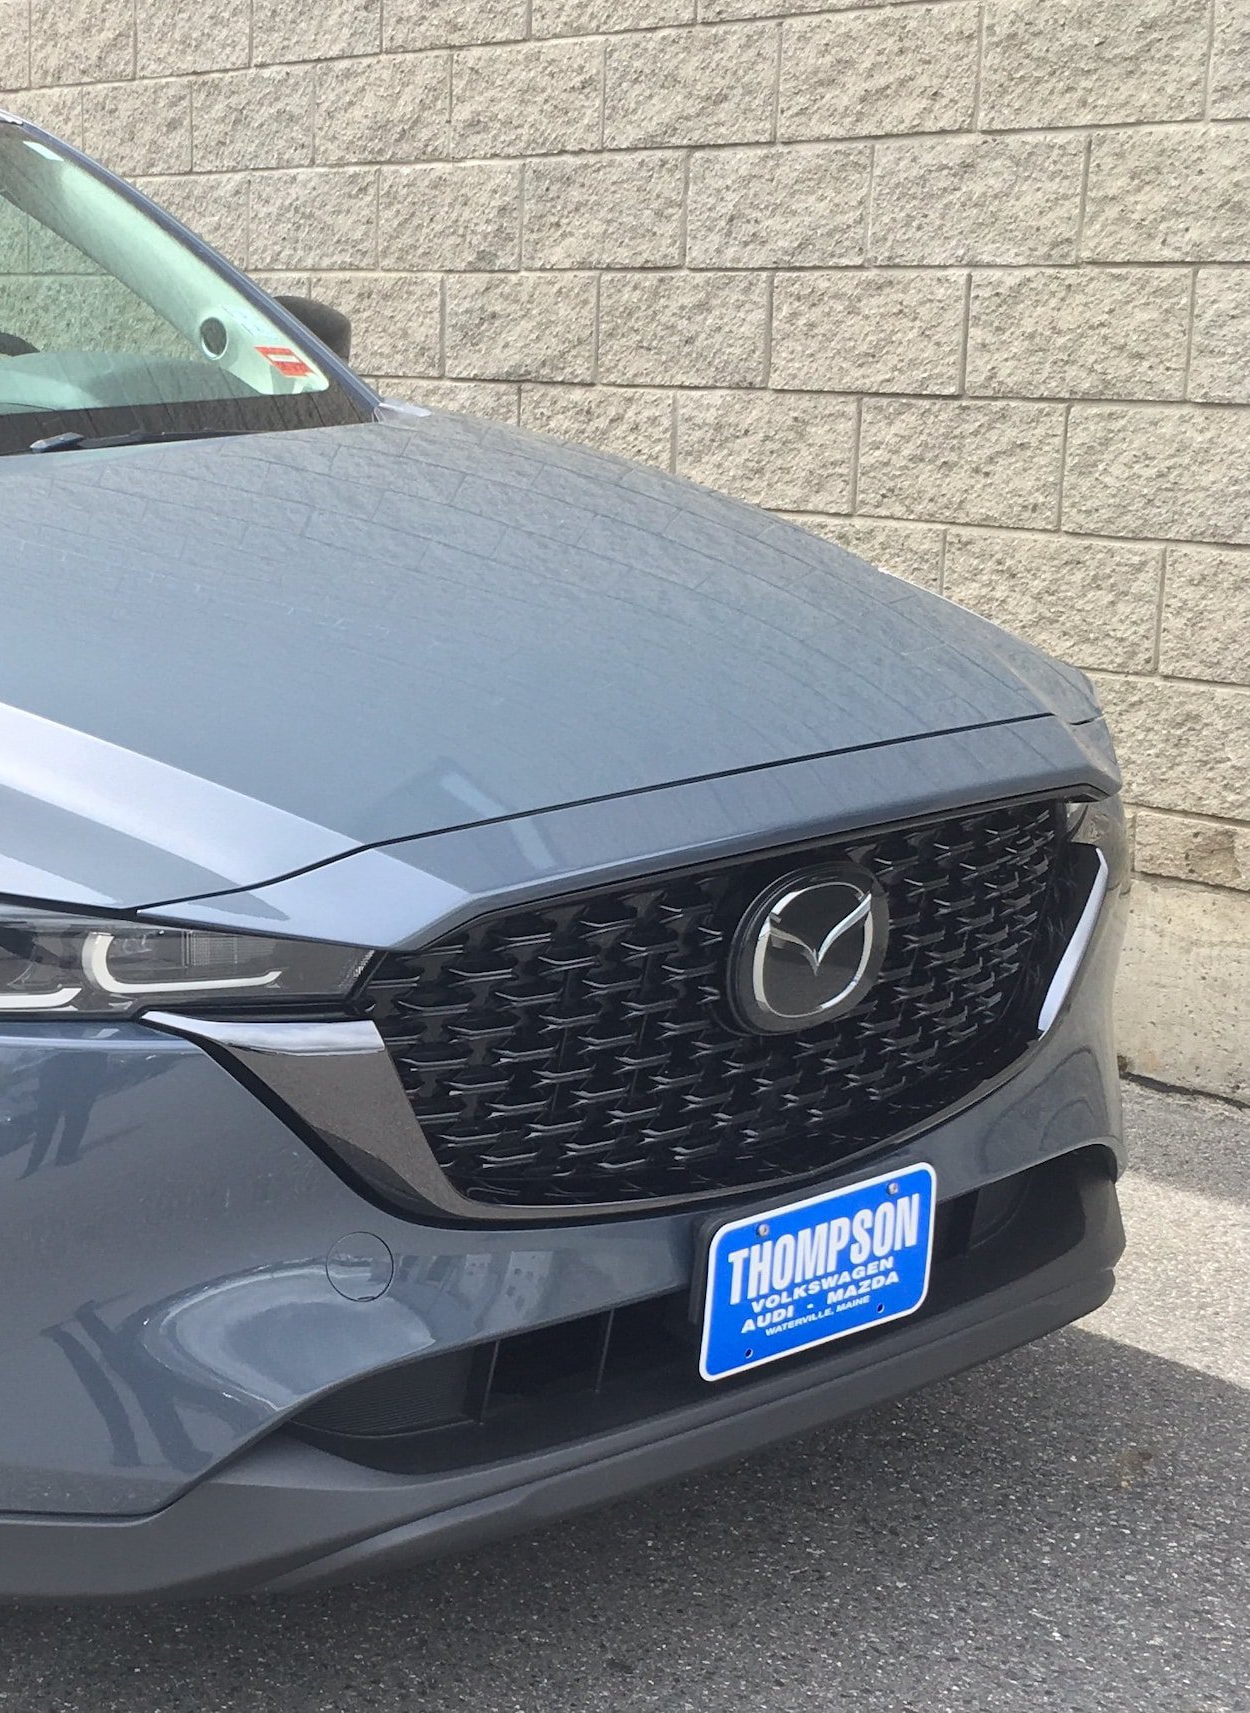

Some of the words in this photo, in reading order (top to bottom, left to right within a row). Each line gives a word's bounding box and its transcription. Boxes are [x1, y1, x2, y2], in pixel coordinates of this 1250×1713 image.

[728, 1192, 920, 1305] THOMPSON
[741, 1304, 794, 1334] AUDI
[826, 1270, 899, 1305] MAZDA
[751, 1255, 895, 1313] VOLKSWAGEN
[836, 1294, 871, 1313] MAINE
